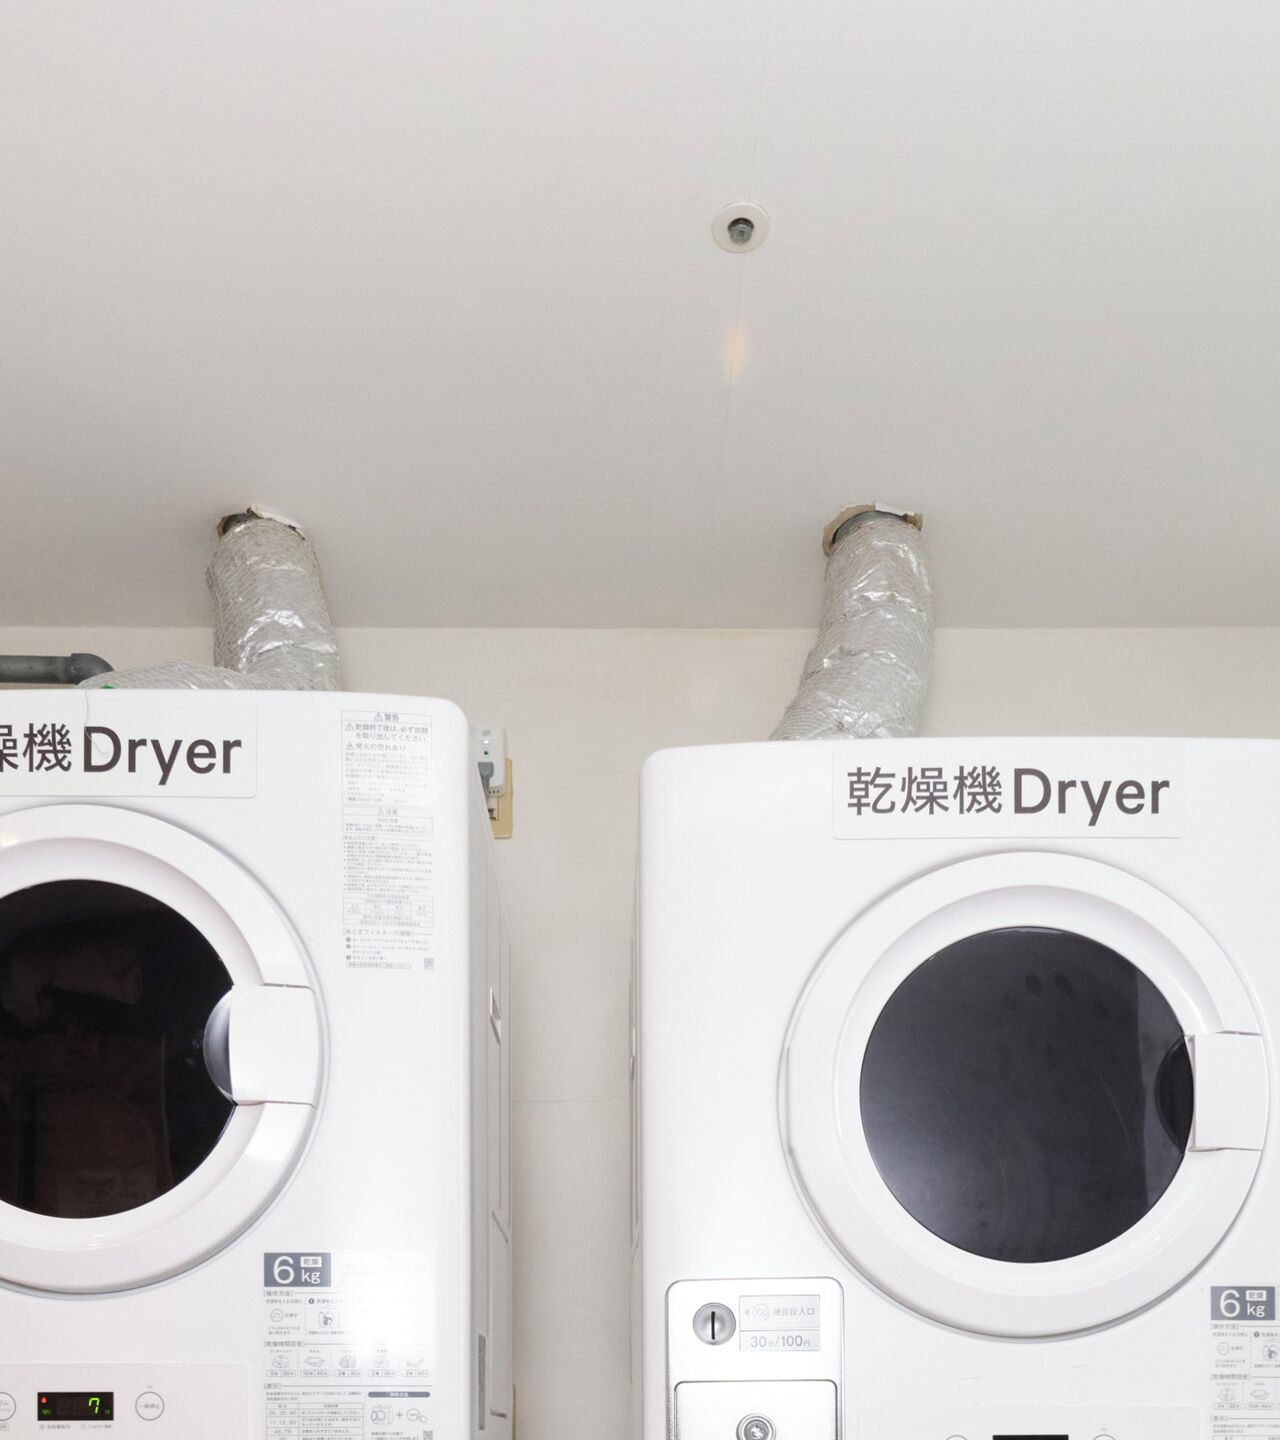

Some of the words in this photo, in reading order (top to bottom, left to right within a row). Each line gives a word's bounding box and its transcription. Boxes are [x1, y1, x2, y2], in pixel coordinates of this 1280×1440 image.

[83, 726, 242, 785] Dryer
[847, 766, 1002, 815] 乾燥機
[1014, 768, 1170, 827] Dryer
[273, 1255, 295, 1285] 6
[301, 1269, 321, 1285] kg
[1219, 1289, 1240, 1318] 6
[1247, 1303, 1266, 1318] kg
